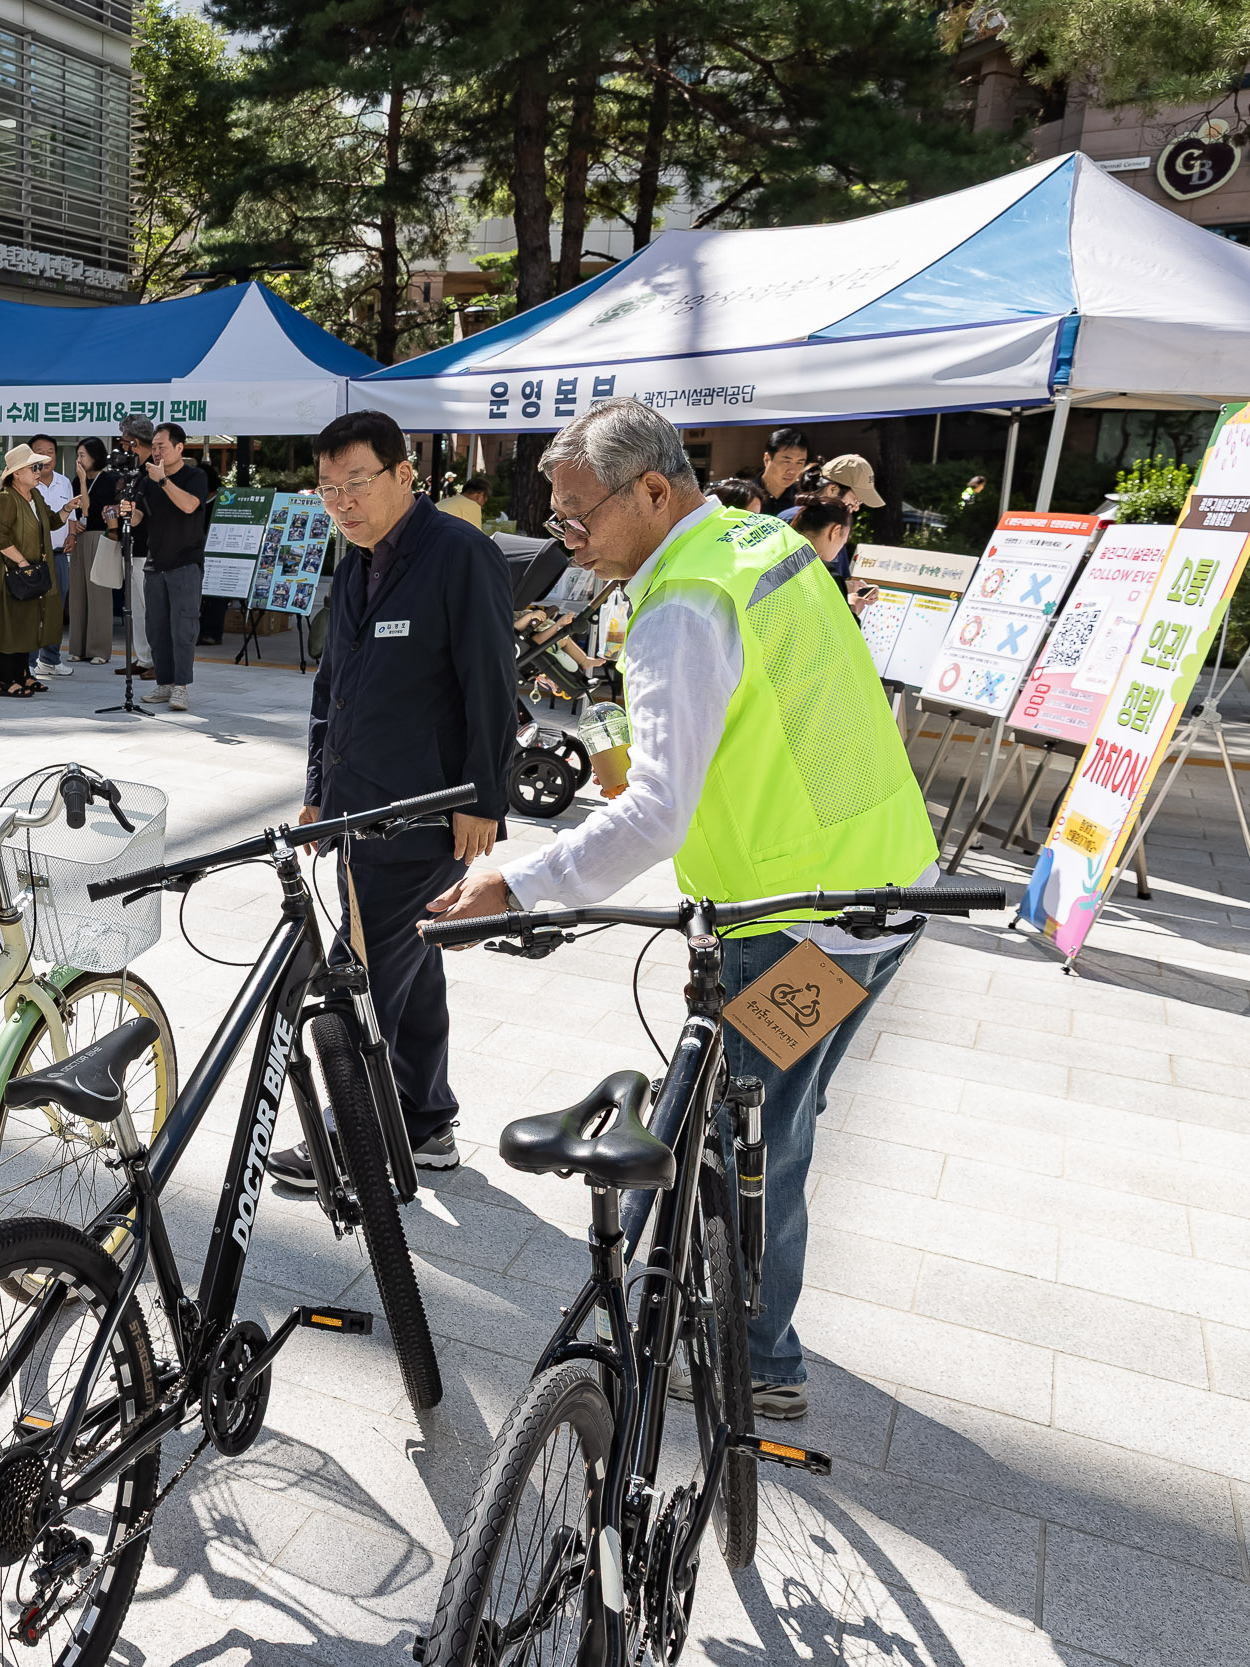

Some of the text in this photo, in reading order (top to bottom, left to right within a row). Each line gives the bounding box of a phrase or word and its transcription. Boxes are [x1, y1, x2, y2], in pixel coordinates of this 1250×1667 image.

[643, 384, 756, 408] 광진구시설관리공단
[6, 402, 39, 423] 수제
[170, 400, 207, 422] 판매
[1100, 547, 1165, 562] 광진구시설관리
[1132, 570, 1157, 583] EVE
[1167, 556, 1220, 607] 소통!
[746, 1000, 774, 1028] 우리동네
[771, 1022, 799, 1050] 자전거포
[232, 1011, 293, 1255] DOCTOR BIKE
